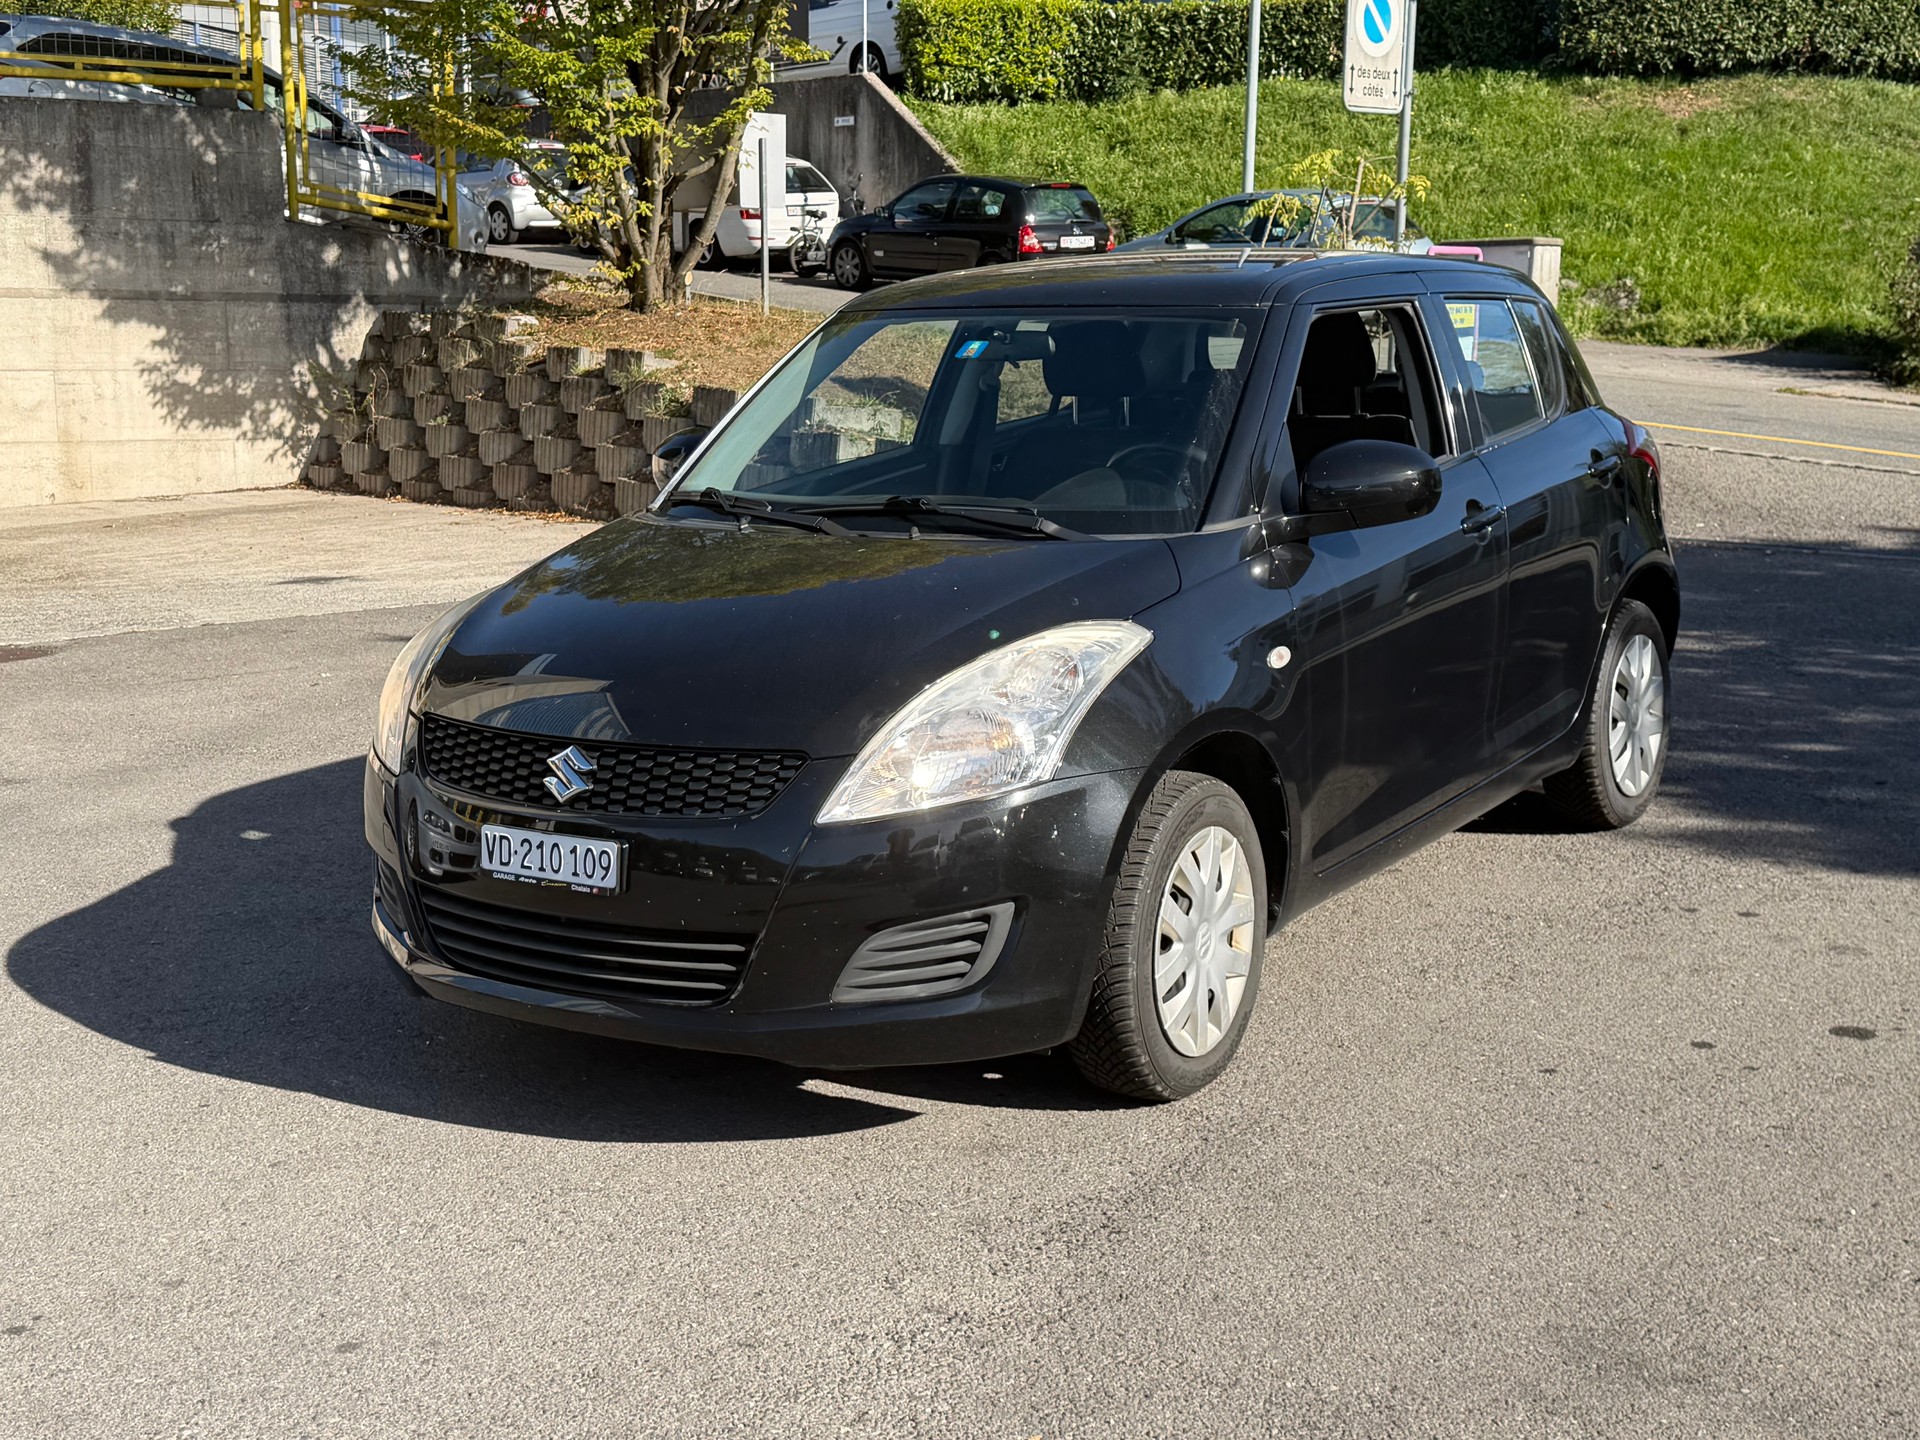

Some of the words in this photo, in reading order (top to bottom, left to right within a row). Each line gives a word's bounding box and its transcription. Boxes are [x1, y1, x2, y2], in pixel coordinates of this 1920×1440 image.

[1357, 65, 1371, 79] des
[1372, 67, 1391, 80] deux
[1362, 83, 1384, 97] côtés
[492, 872, 516, 881] GARAGE
